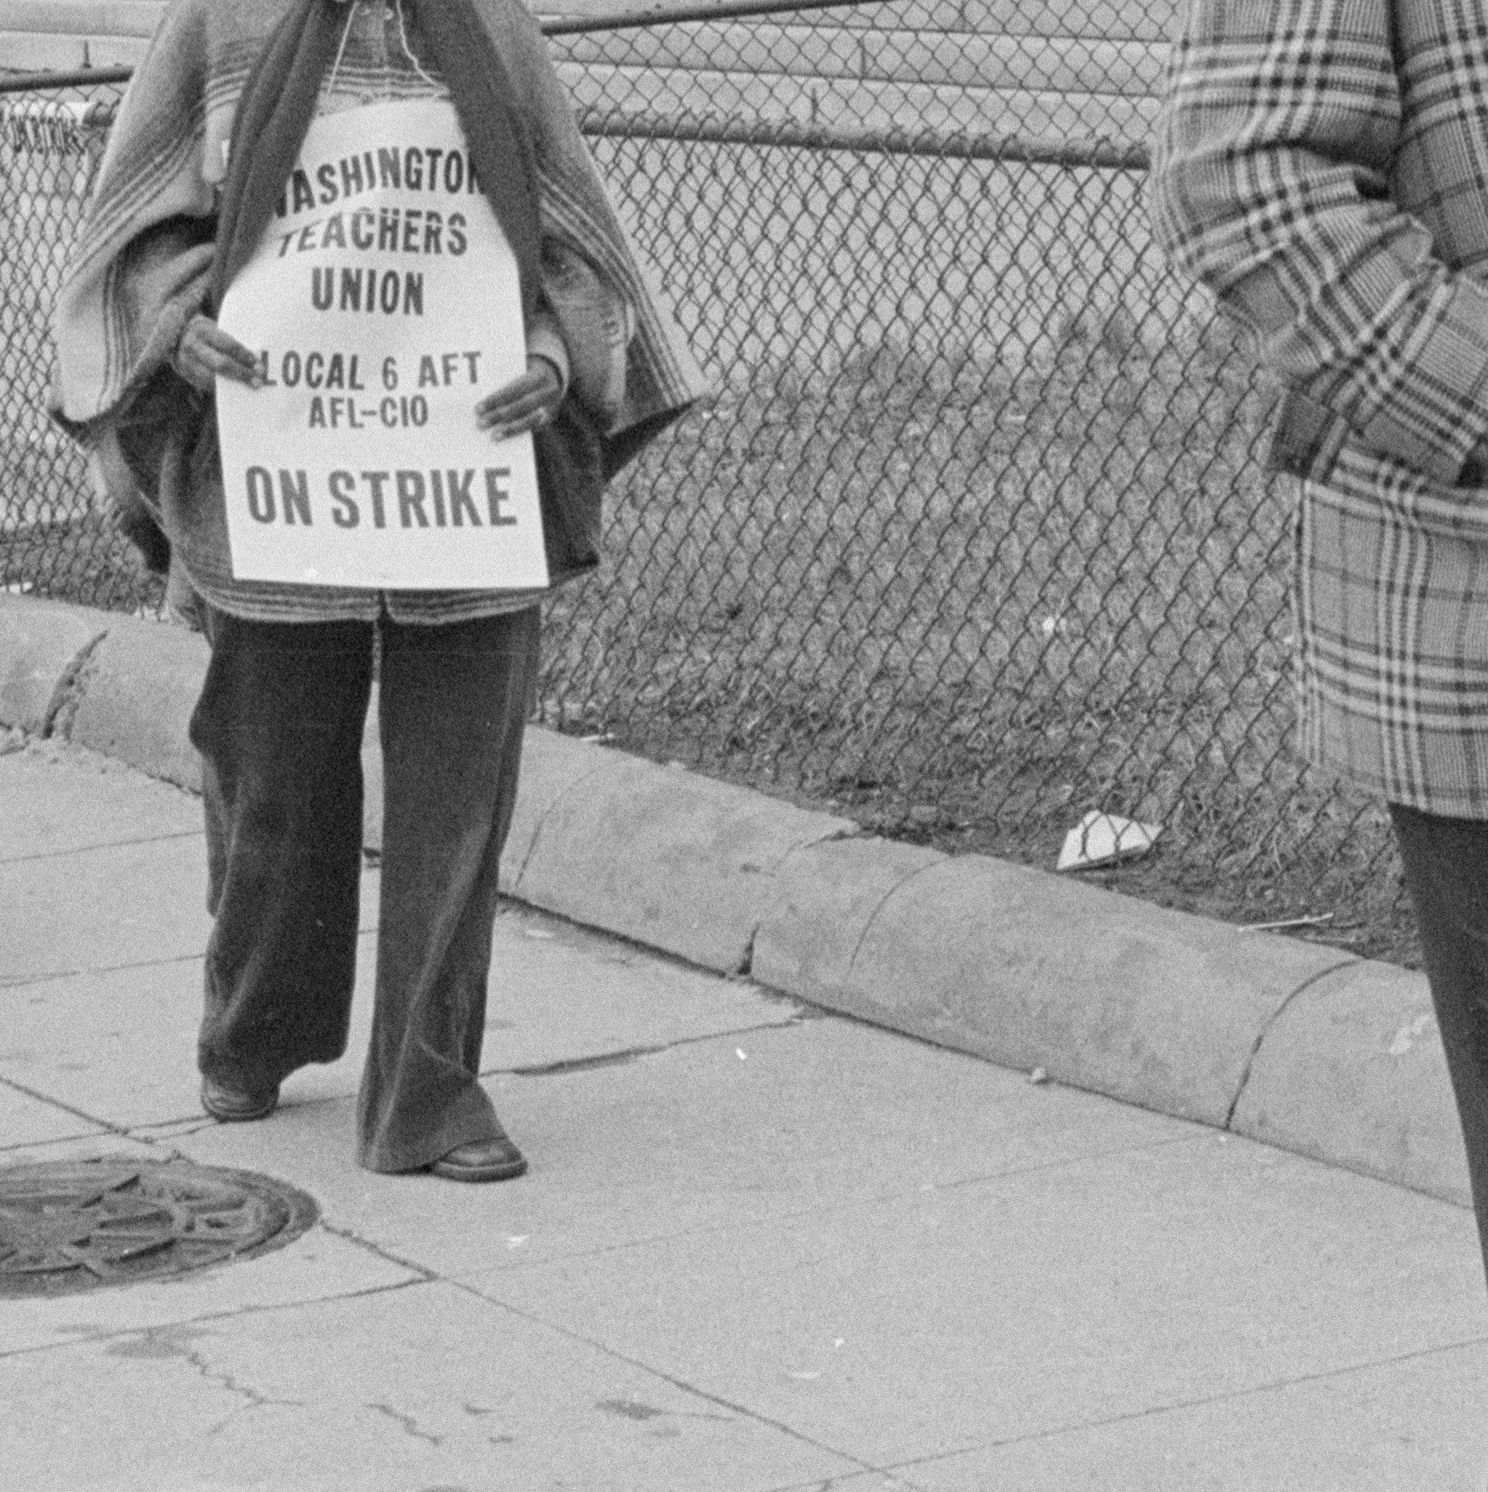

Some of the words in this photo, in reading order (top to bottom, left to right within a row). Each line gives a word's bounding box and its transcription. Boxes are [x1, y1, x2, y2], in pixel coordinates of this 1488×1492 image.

[274, 145, 487, 219] ASHINGTON
[278, 207, 468, 258] TEACHERS
[311, 266, 424, 316] UNION
[260, 350, 365, 391] LOCAL
[381, 355, 399, 391] 6
[418, 351, 482, 388] AFT
[308, 394, 429, 429] AFL-CIO
[245, 465, 314, 527] ON
[327, 466, 518, 530] STRIKE
